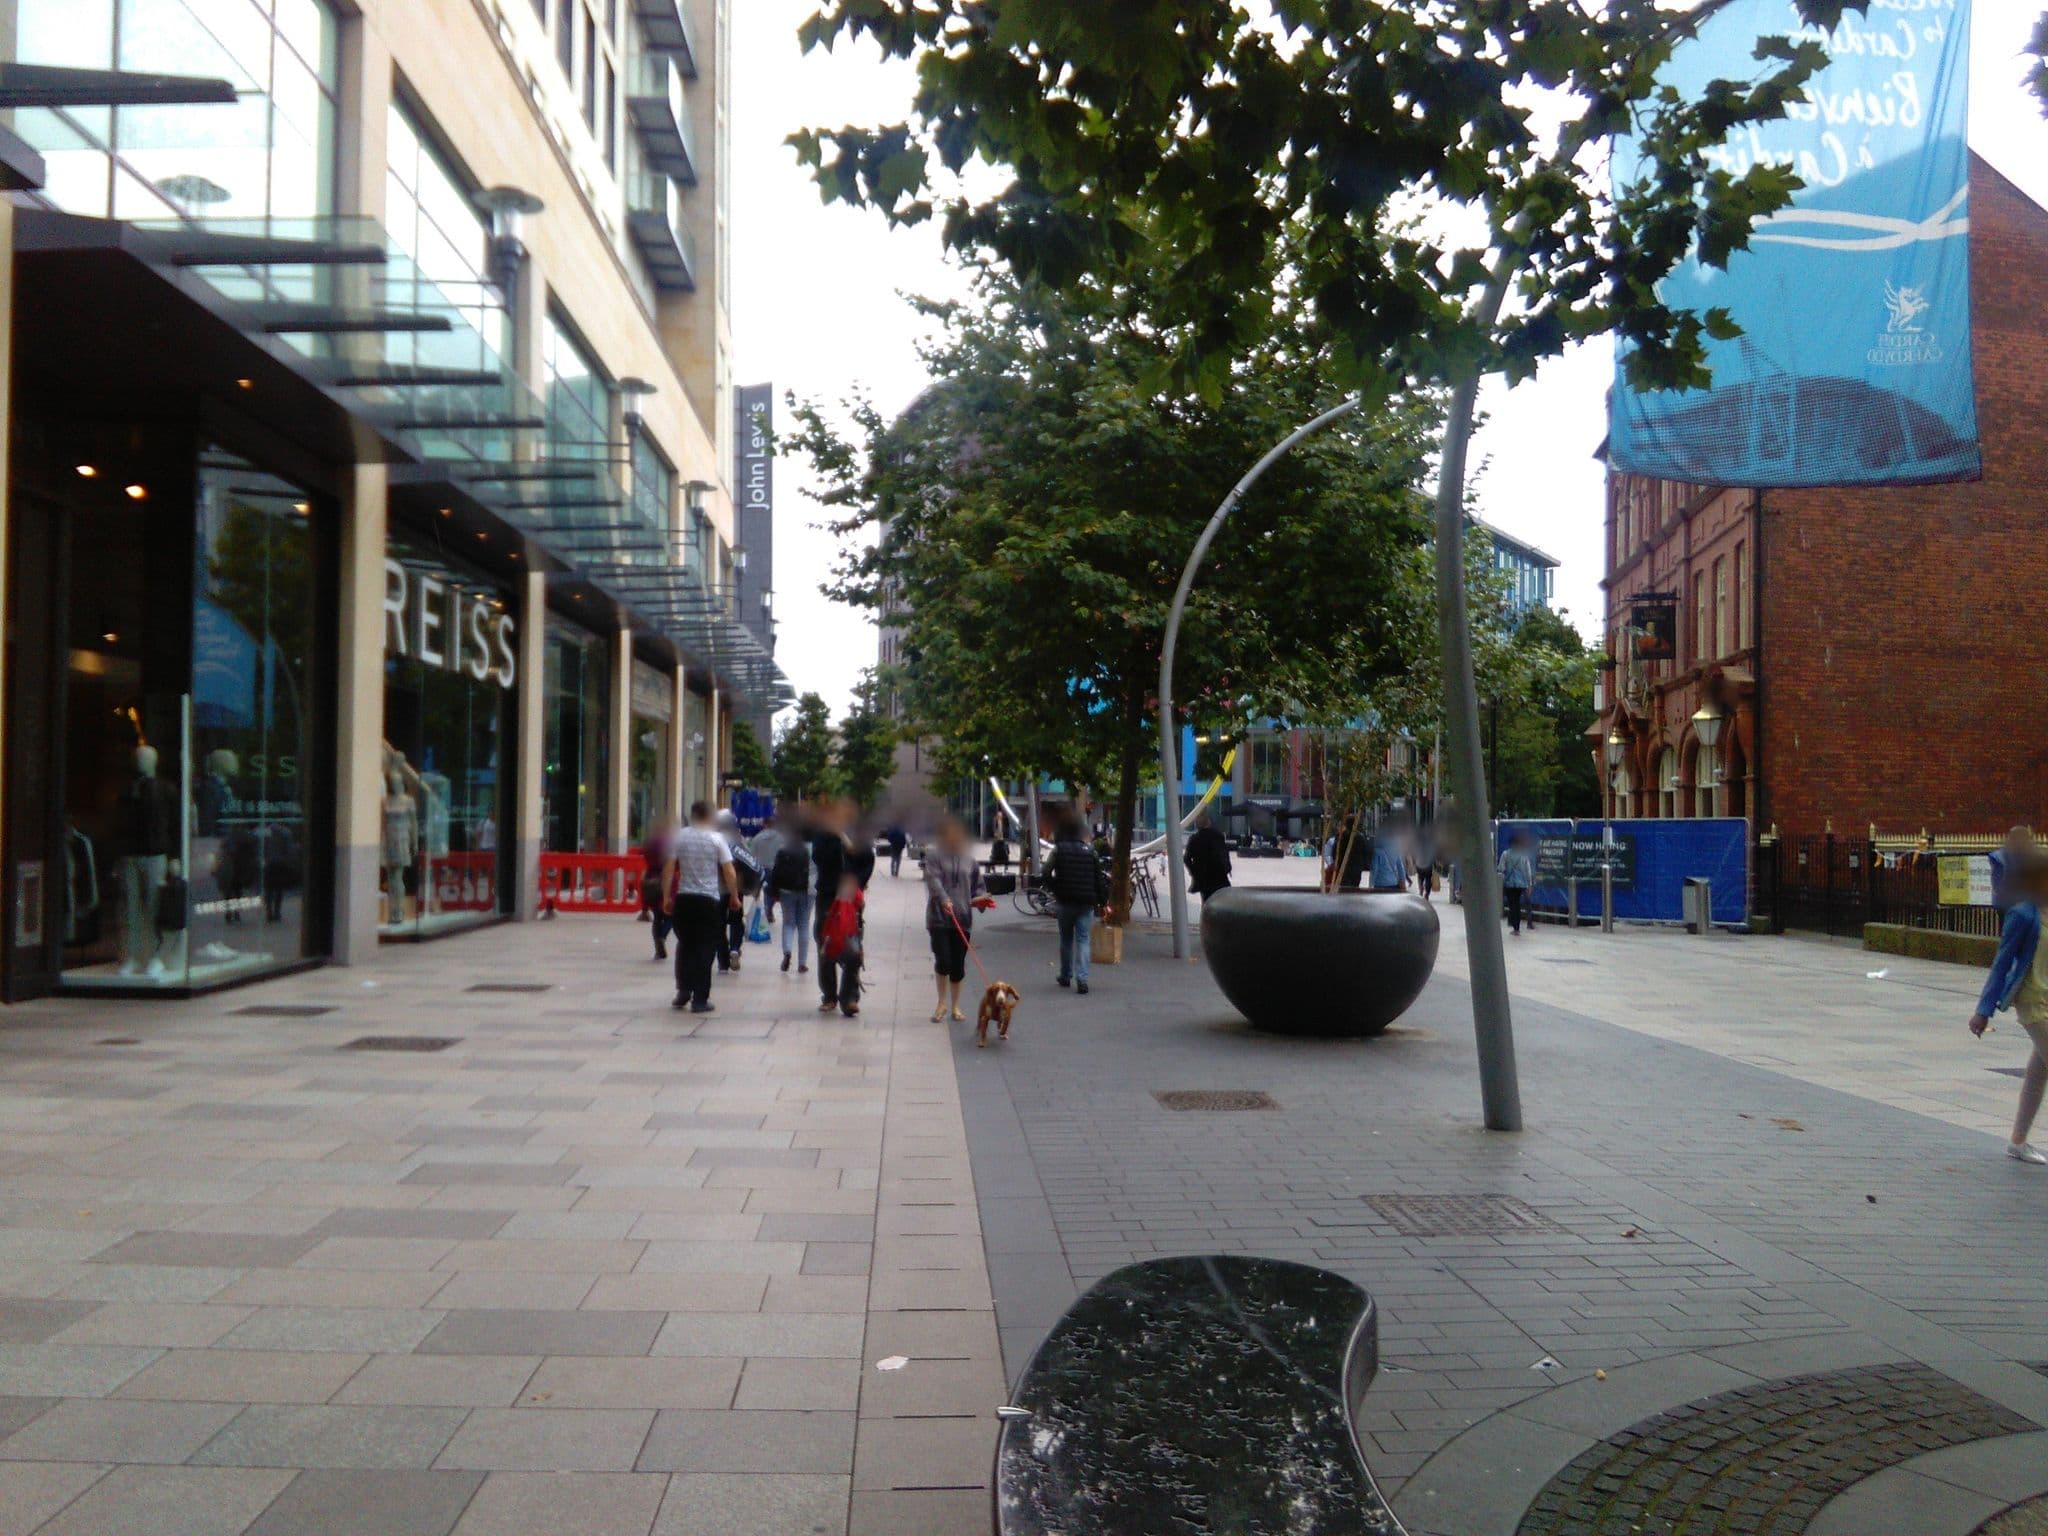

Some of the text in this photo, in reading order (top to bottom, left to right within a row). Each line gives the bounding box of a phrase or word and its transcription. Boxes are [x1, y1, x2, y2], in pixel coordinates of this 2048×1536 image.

[746, 463, 770, 511] John
[384, 556, 515, 690] REISS
[1572, 841, 1627, 851] NOW HIING
